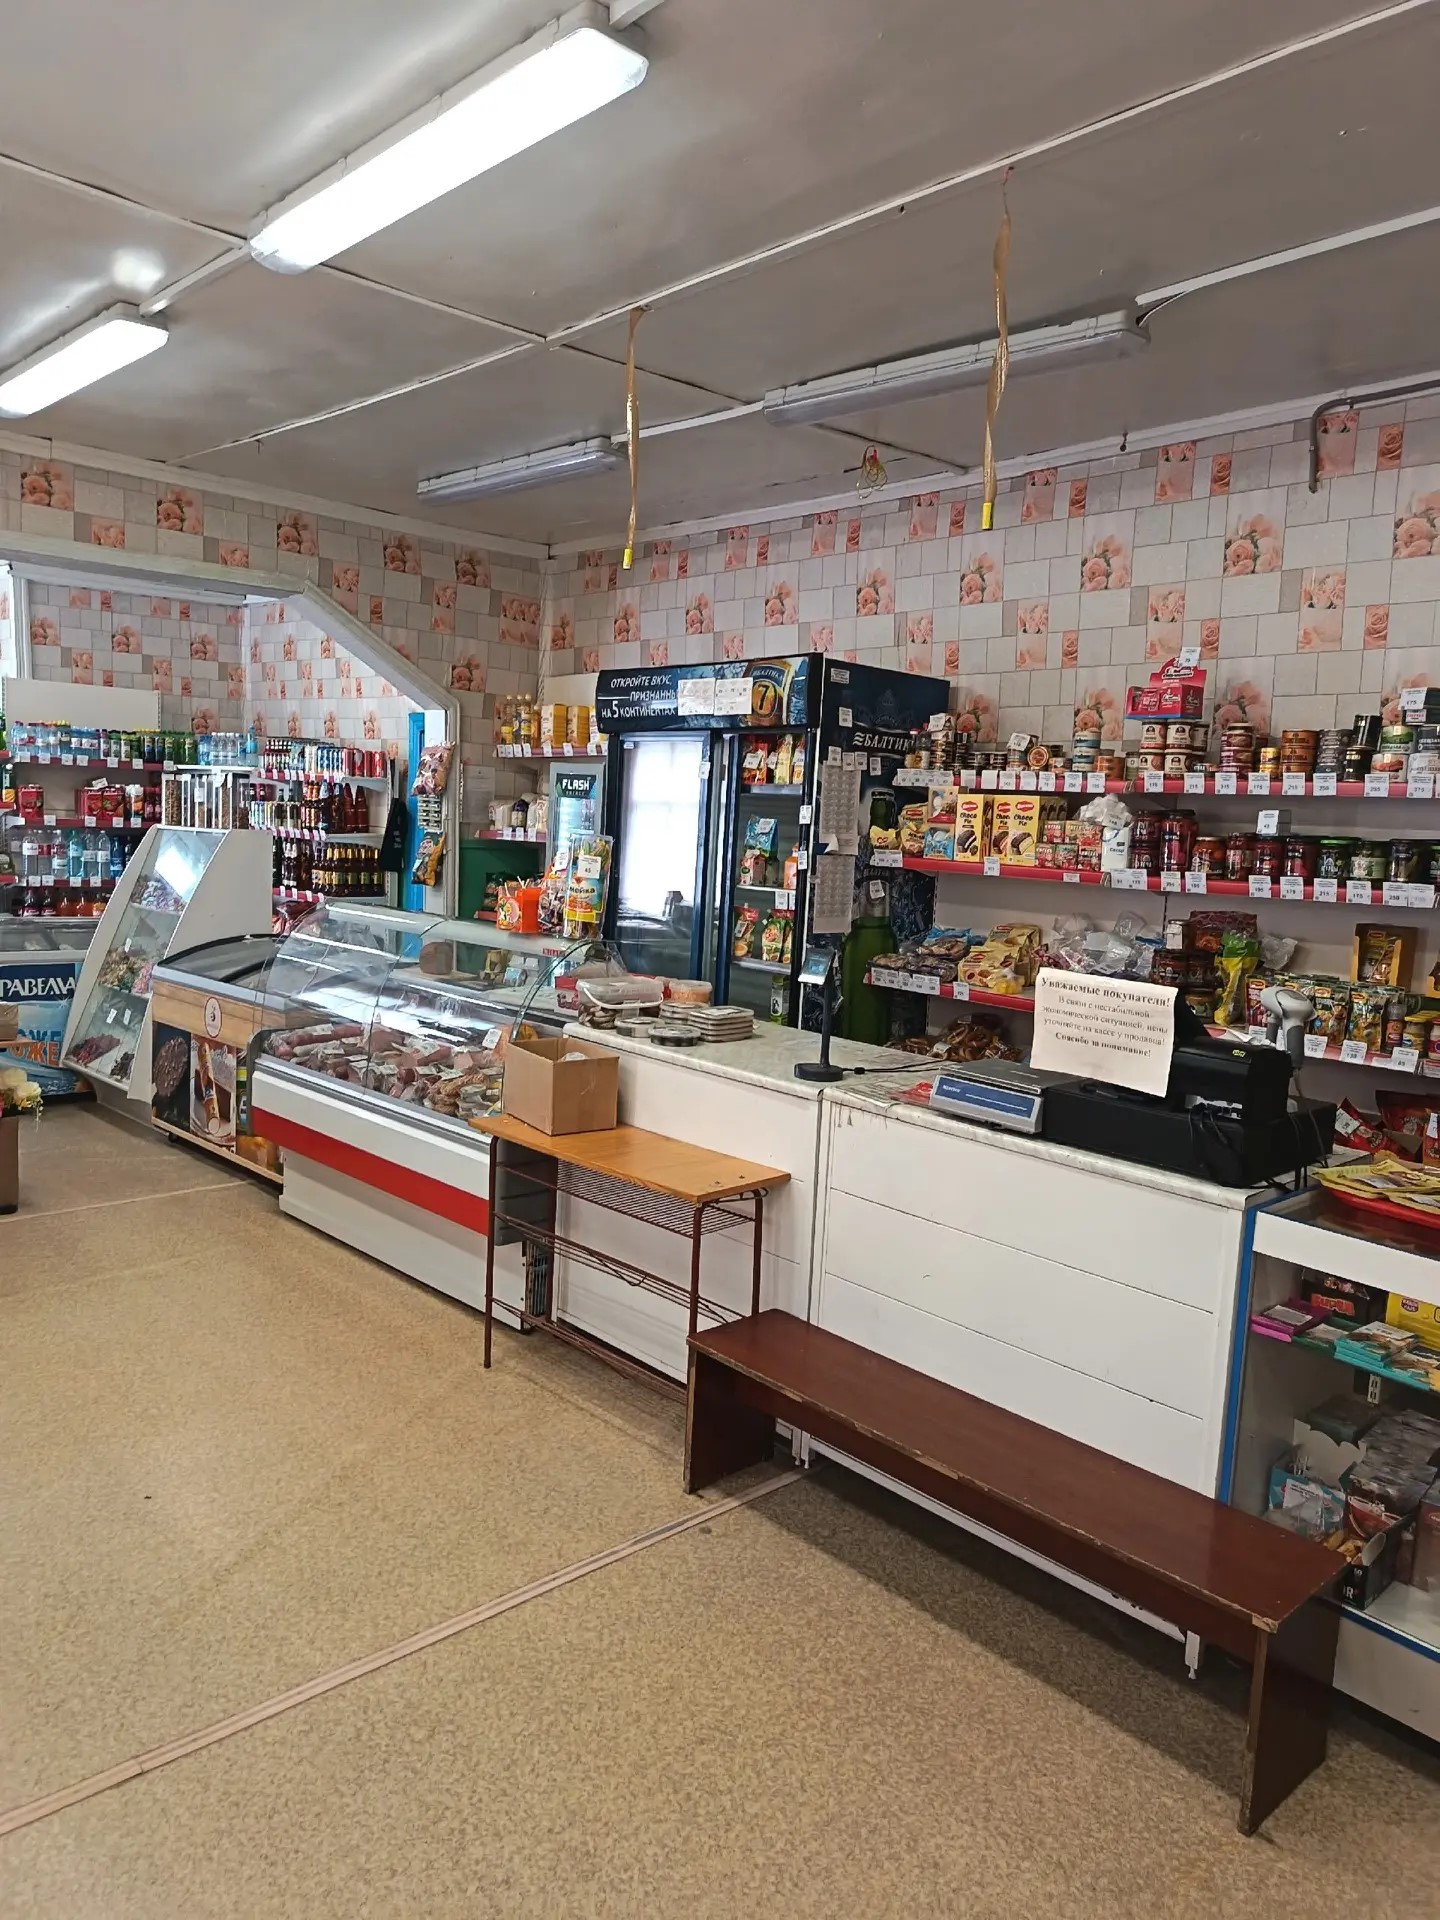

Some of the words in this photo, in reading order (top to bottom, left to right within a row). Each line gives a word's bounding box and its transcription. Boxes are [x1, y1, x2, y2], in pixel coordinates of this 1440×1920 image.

[610, 674, 651, 689] ОТКРОЙТЕ
[650, 674, 673, 686] ВКУС,
[757, 683, 770, 711] 7
[601, 707, 612, 719] НА
[612, 700, 619, 718] 5
[619, 705, 676, 718] КОНТИНЕНТАХ
[864, 733, 915, 751] БАЛТИК
[562, 778, 590, 791] FLASH
[1013, 813, 1034, 821] Choco
[1041, 977, 1101, 996] Уважаемые
[1103, 989, 1170, 1008] покупатели!
[1058, 995, 1065, 1004] В
[1065, 998, 1087, 1008] связи
[1094, 1003, 1150, 1019] нестабильной
[1042, 1005, 1099, 1022] экономической
[1146, 1024, 1168, 1034] цены
[1044, 1018, 1081, 1031] уточняйте
[1082, 1025, 1092, 1033] на
[1094, 1028, 1116, 1037] кассе
[1117, 1031, 1123, 1040] у
[1124, 1033, 1165, 1046] продавца!
[1055, 1032, 1089, 1045] Спасибо
[1101, 1042, 1151, 1057] понимание!
